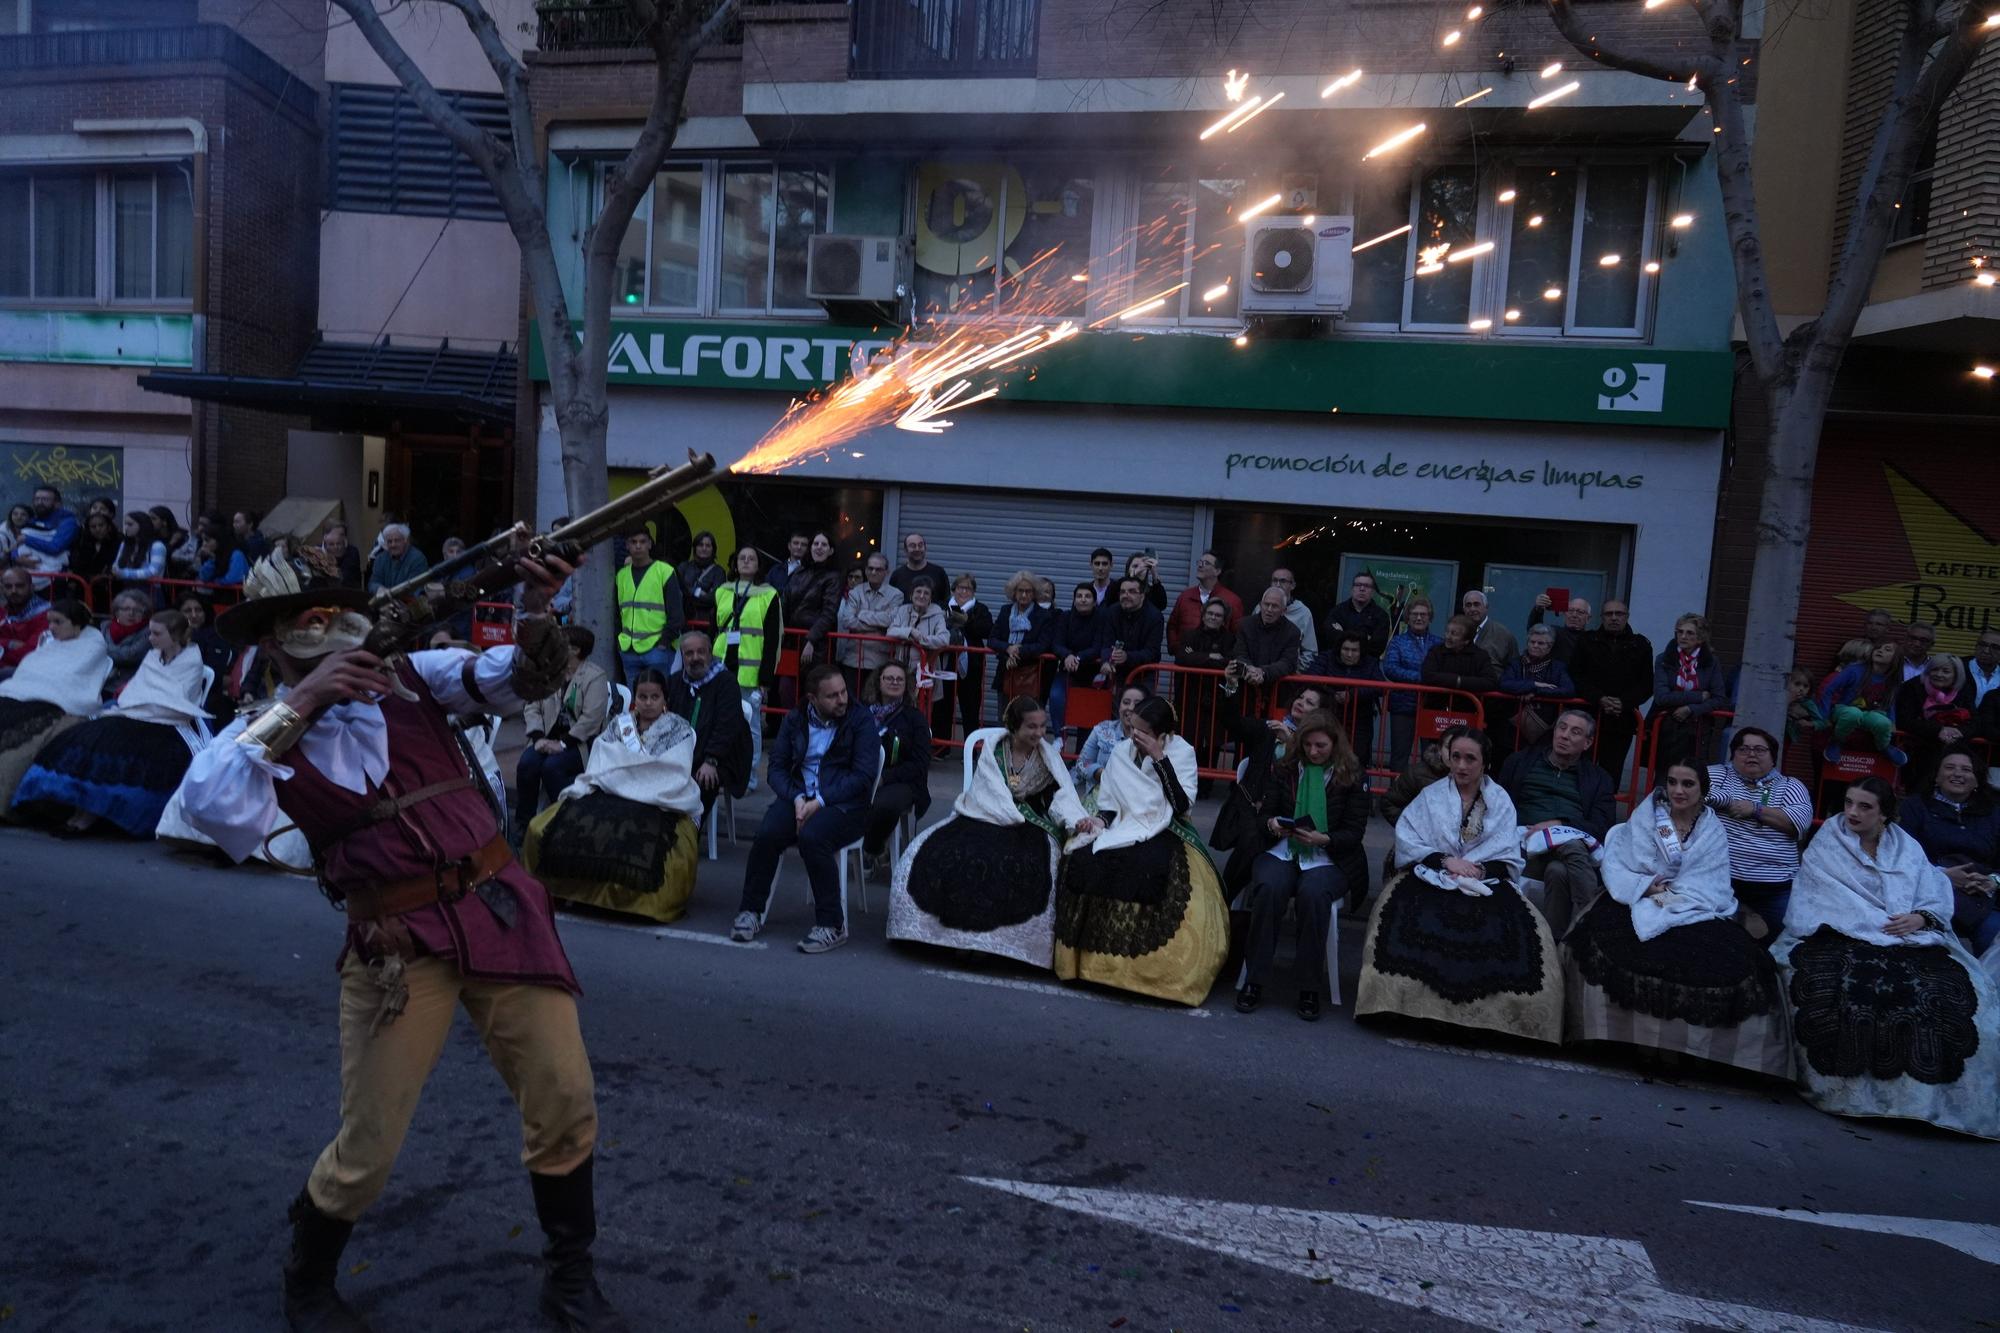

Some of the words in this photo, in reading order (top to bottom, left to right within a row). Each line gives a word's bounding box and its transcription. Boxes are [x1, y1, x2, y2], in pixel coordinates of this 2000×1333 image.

[1225, 453, 1366, 480] promoción
[1371, 452, 1409, 478] de
[1415, 458, 1537, 494] energías
[1543, 460, 1644, 499] limpias
